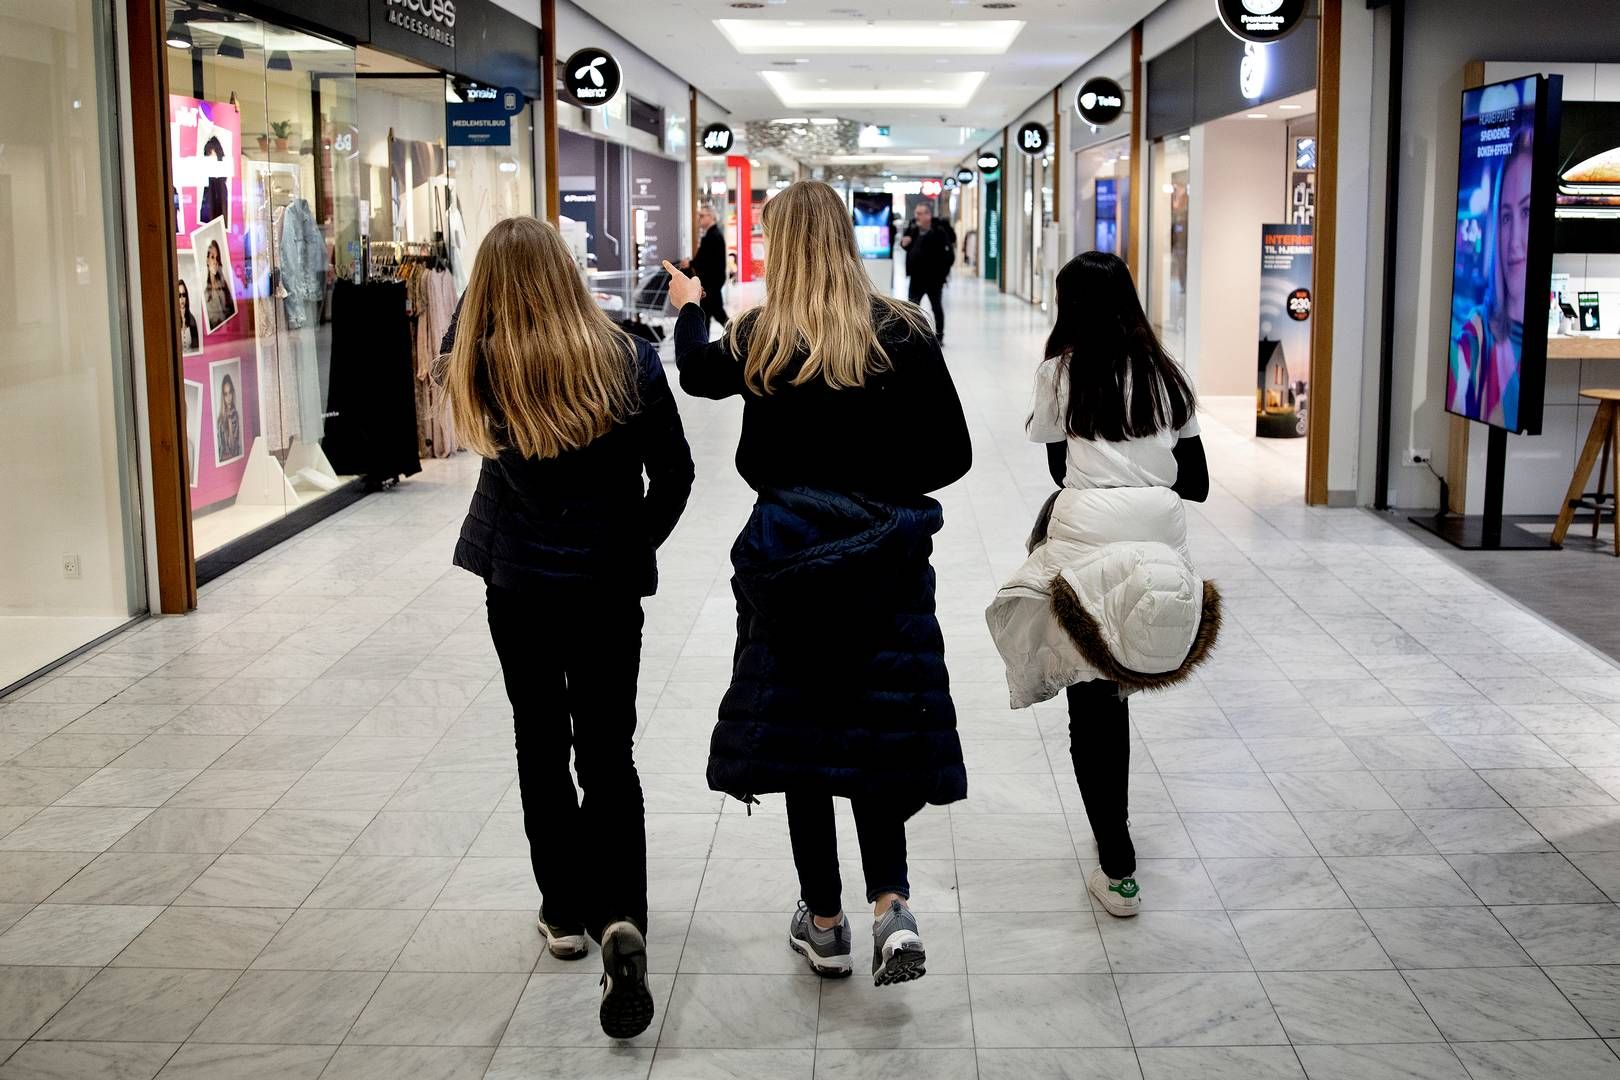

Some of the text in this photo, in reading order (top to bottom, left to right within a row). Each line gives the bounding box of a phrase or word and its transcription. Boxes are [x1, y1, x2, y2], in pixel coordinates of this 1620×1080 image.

[388, 9, 455, 48] ACCESSORIES
[452, 119, 506, 127] MEDLEMSTILBUD
[1265, 234, 1312, 245] INTERNE
[1265, 245, 1278, 254] TIL
